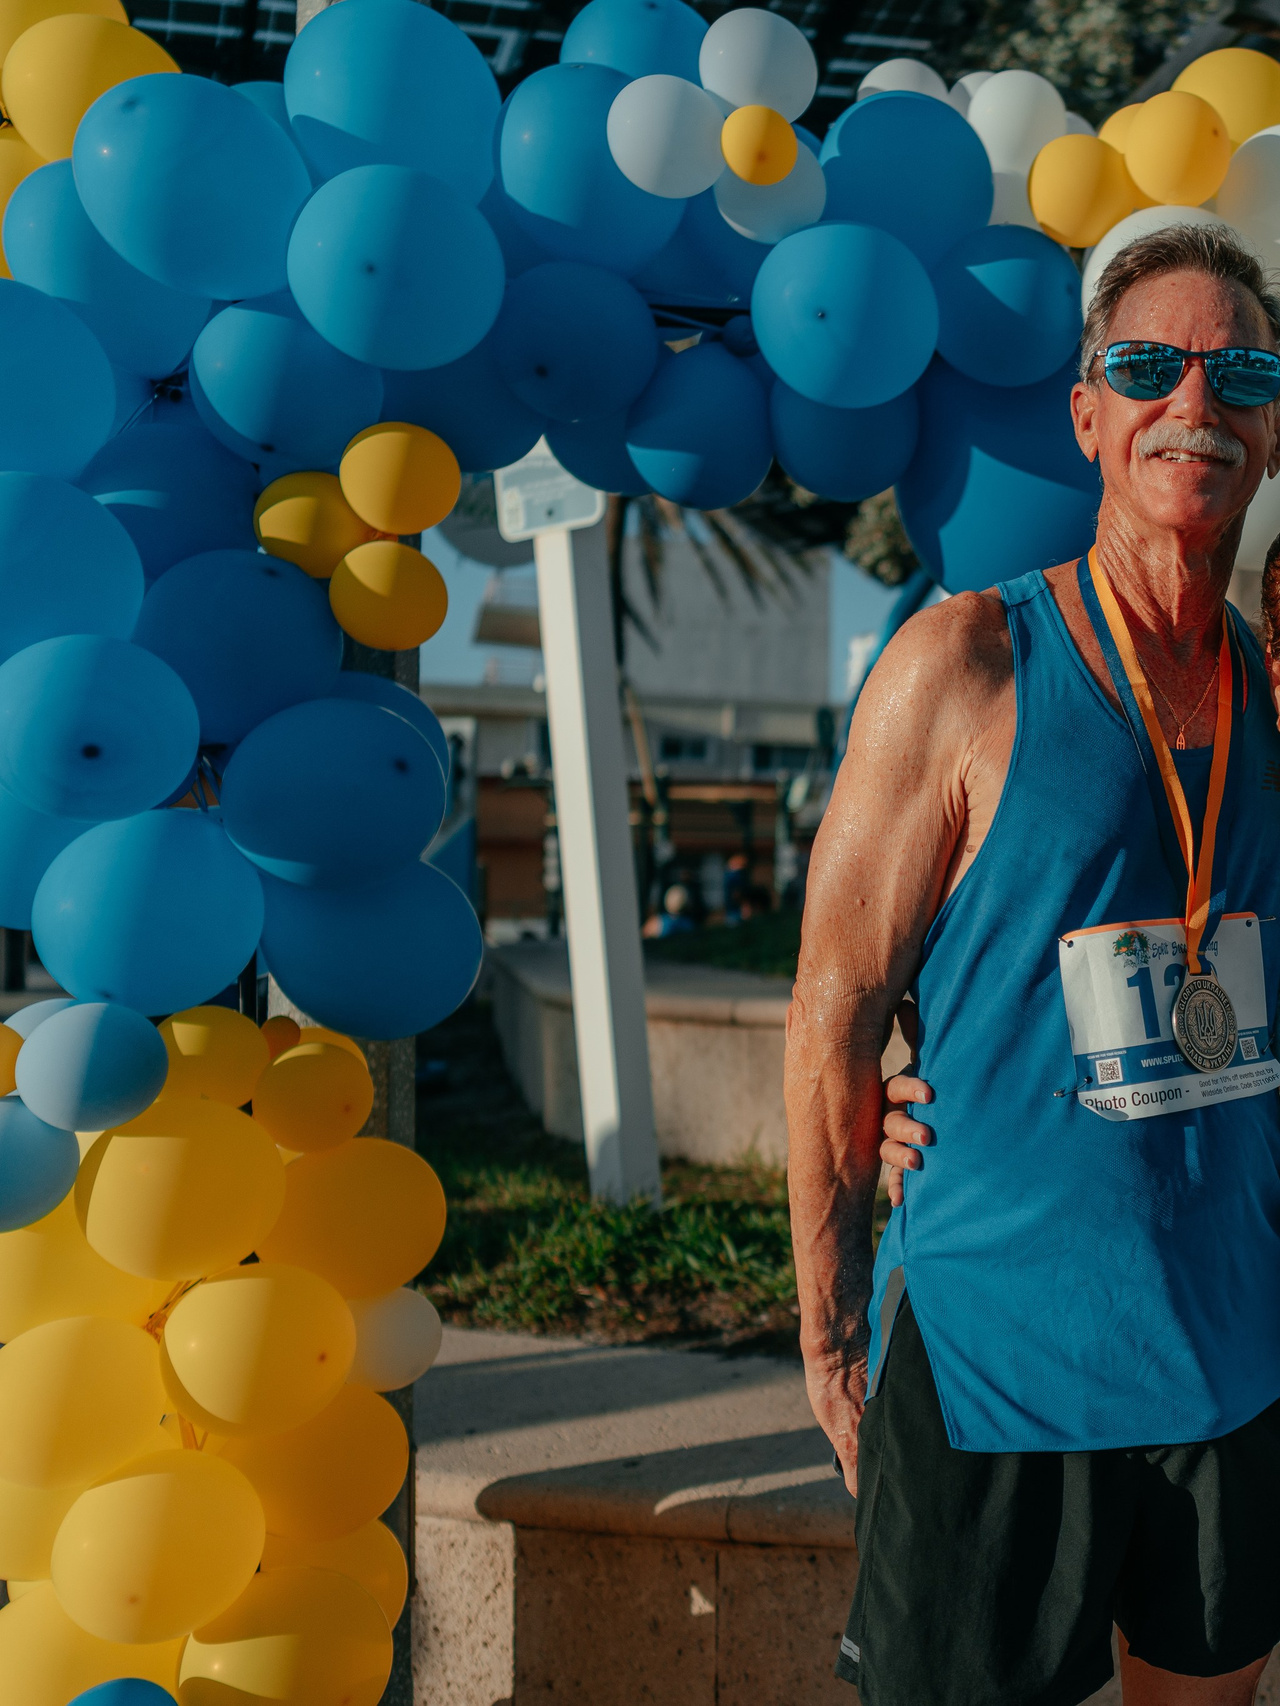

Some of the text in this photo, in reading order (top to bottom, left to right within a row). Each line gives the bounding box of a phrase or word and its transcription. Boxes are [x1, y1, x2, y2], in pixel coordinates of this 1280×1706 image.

[1151, 942, 1169, 960] Split
[1179, 985, 1194, 1011] GLORY
[1193, 981, 1202, 990] TO
[1199, 1080, 1211, 1088] Good
[1239, 1071, 1256, 1079] events
[1256, 1069, 1265, 1077] shot
[1201, 1087, 1223, 1097] Wildside
[1240, 1081, 1253, 1090] Code
[1085, 1095, 1127, 1111] Photo
[1131, 1087, 1182, 1106] Coupon
